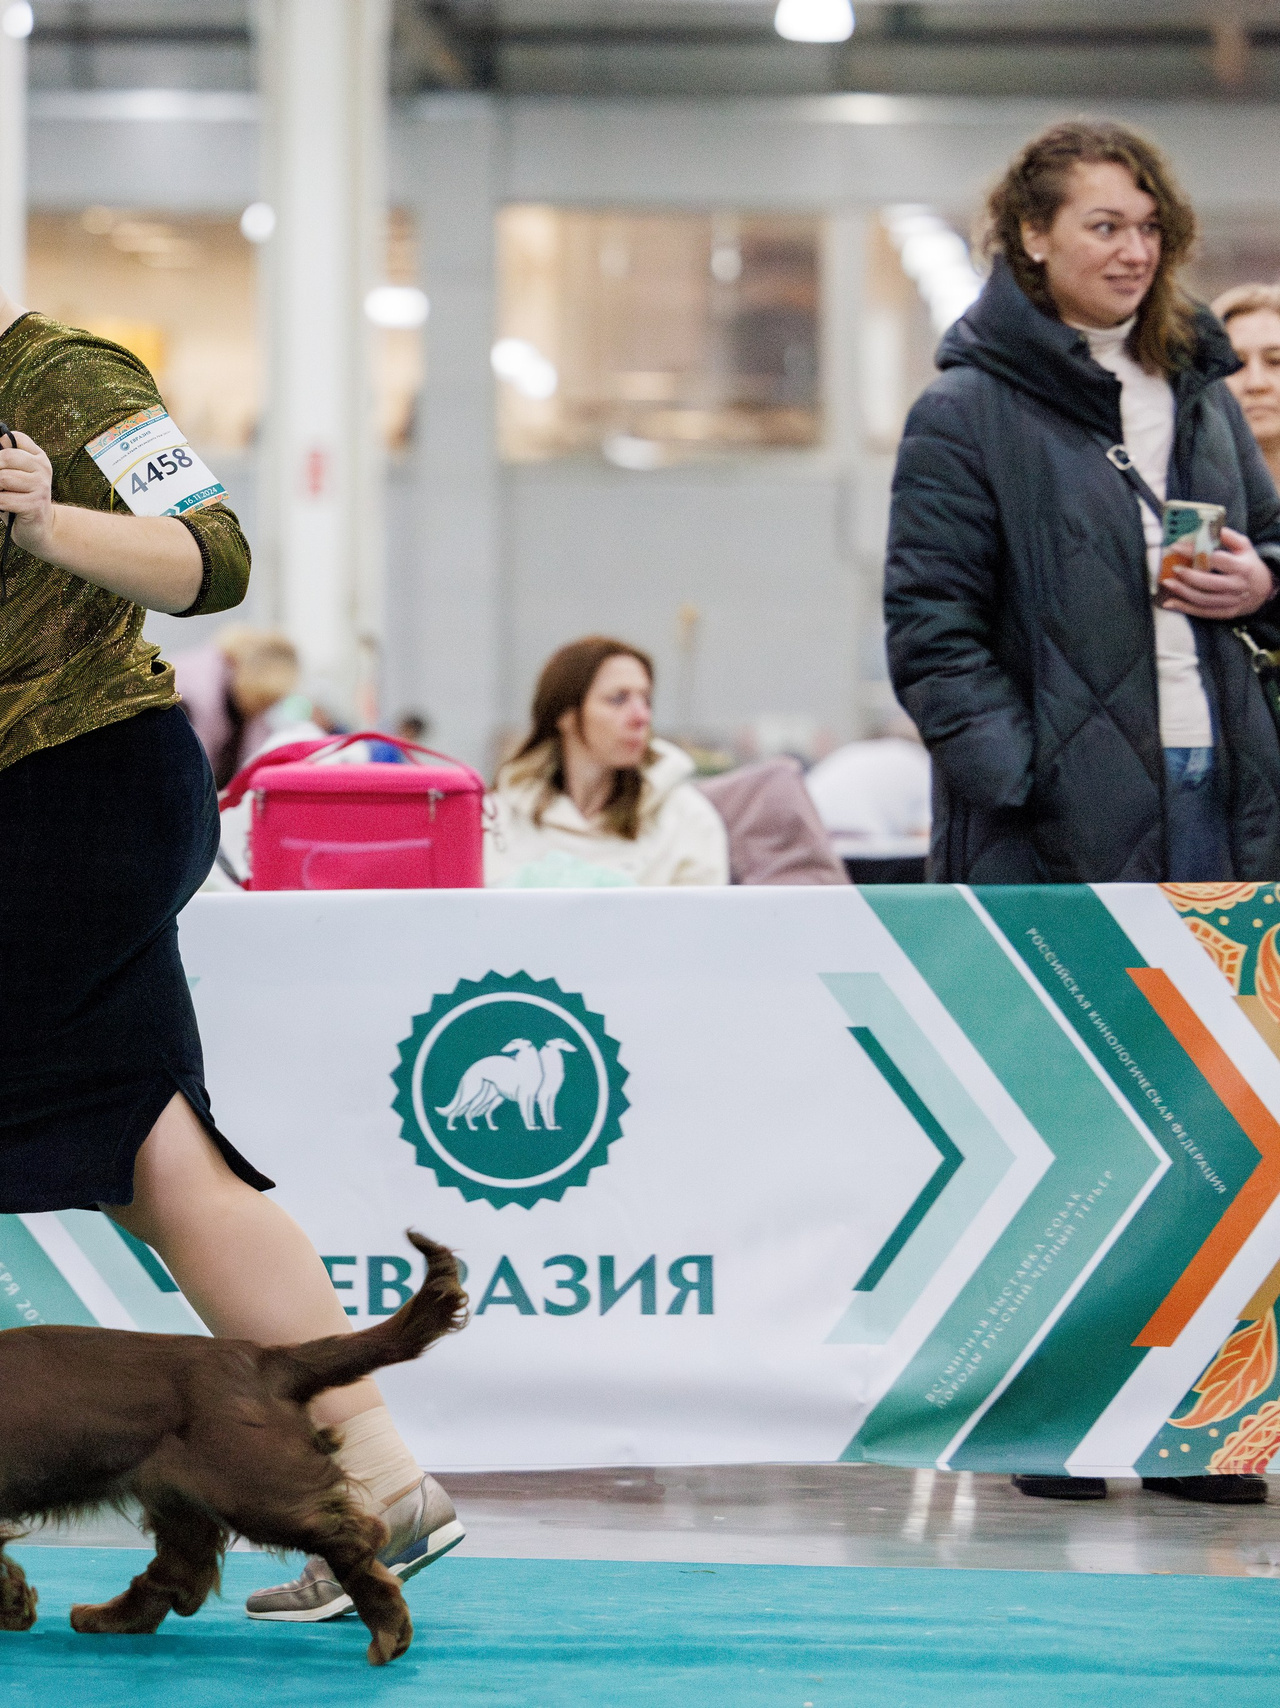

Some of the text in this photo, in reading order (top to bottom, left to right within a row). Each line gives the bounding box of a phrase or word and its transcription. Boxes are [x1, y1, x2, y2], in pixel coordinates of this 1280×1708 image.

[131, 448, 193, 495] 4458
[184, 487, 217, 506] 16.11.2024
[1025, 927, 1227, 1194] РОССИЙСКАЯ КИНОЛОГИЧЕСКАЯ ФЕДЕРАЦИЯ
[320, 1253, 715, 1317] ЕВАЗИЯ
